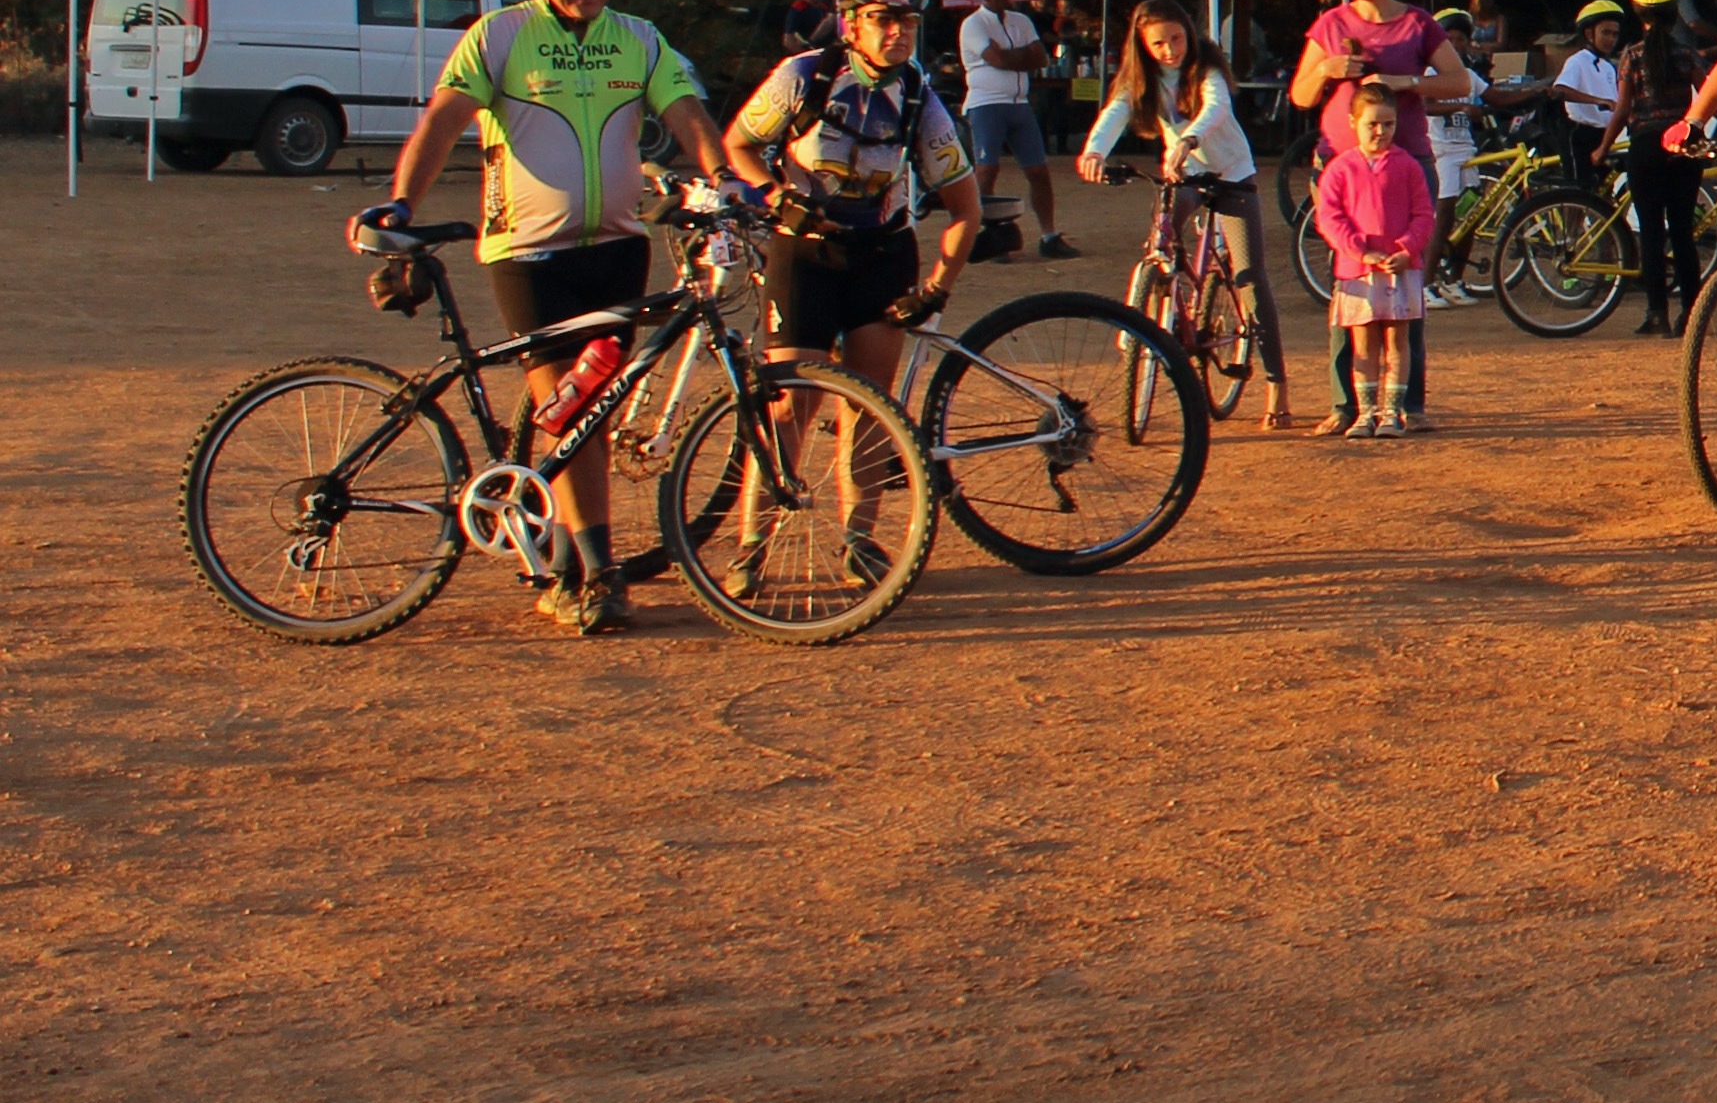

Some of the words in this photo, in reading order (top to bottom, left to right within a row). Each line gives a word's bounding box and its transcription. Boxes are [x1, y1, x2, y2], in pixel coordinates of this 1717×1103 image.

[538, 43, 623, 57] CALVINIA
[552, 57, 613, 71] Motors
[607, 80, 644, 90] ISUZU
[552, 359, 650, 460] GIANT
